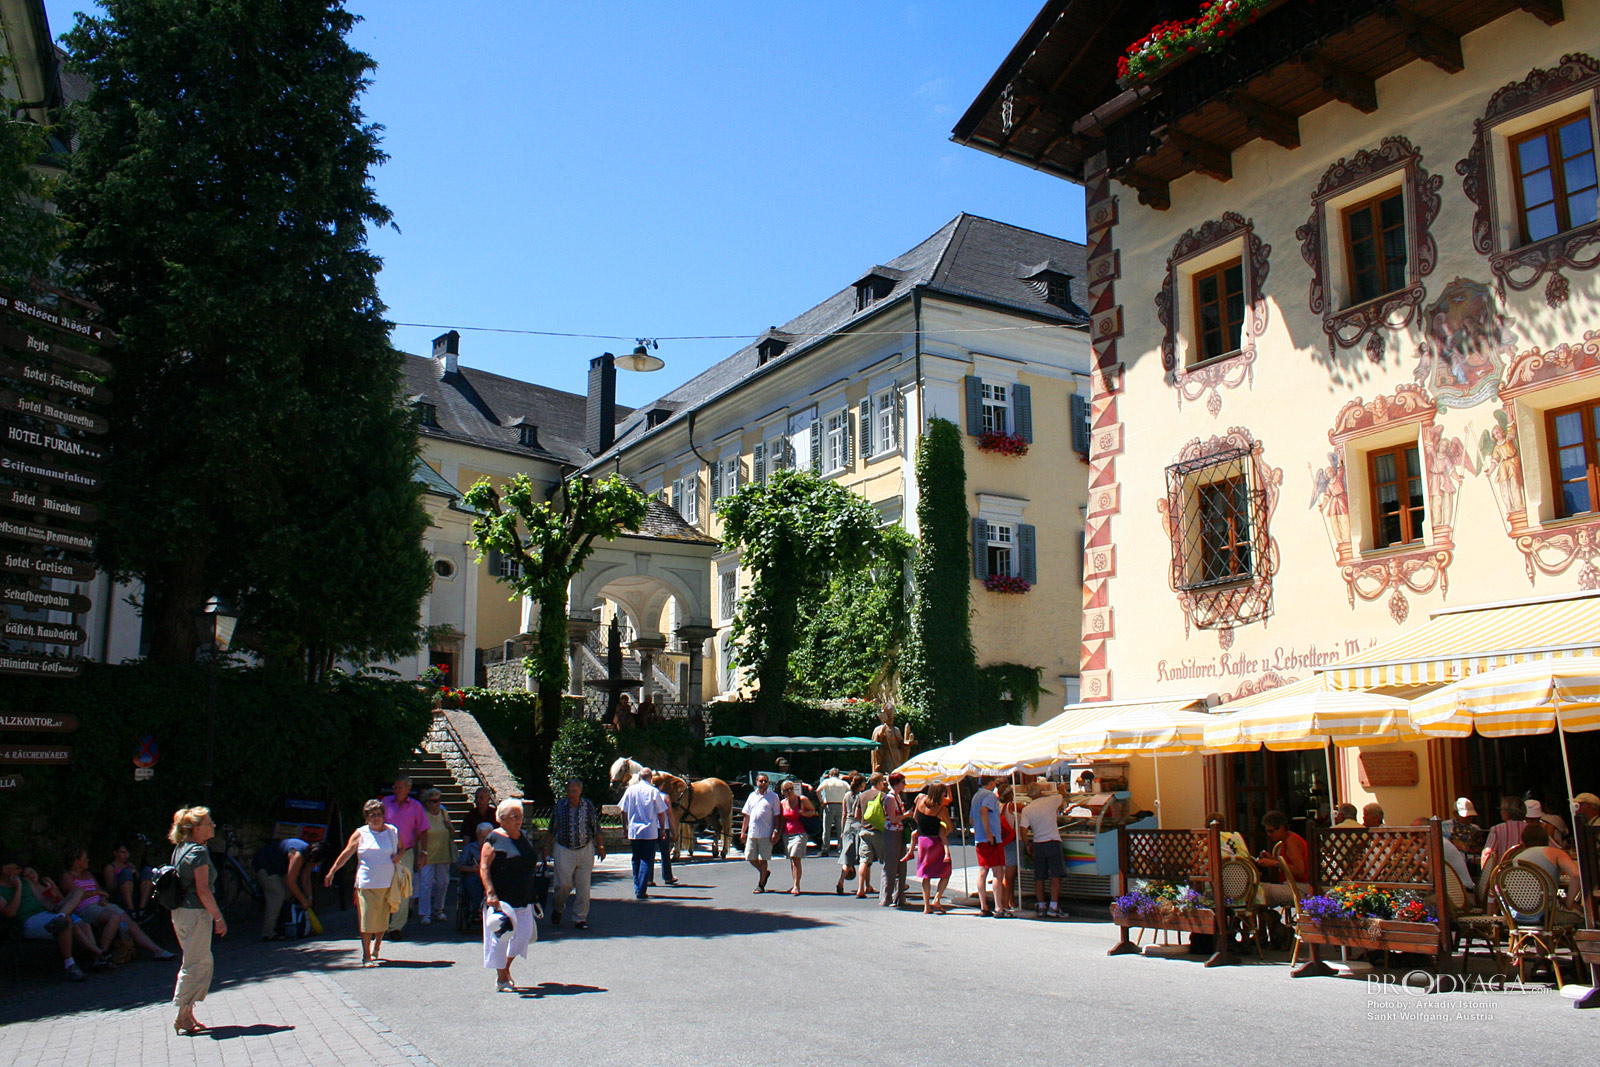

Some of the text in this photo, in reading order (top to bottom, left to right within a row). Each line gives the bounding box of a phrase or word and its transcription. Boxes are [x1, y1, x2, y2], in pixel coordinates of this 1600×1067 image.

[14, 300, 58, 324] Weissen
[61, 316, 91, 335] Rössl
[24, 366, 47, 382] Hotel
[18, 398, 94, 428] Hotel Margaretha
[8, 426, 80, 455] HOTEL FURIAN
[1, 458, 96, 486] Seifenmanufaktur
[11, 491, 81, 515] Hotel Mirabell
[46, 530, 93, 547] Promenade
[1219, 651, 1258, 679] Kaffee
[12, 749, 68, 759] RÄUCHERWAREN
